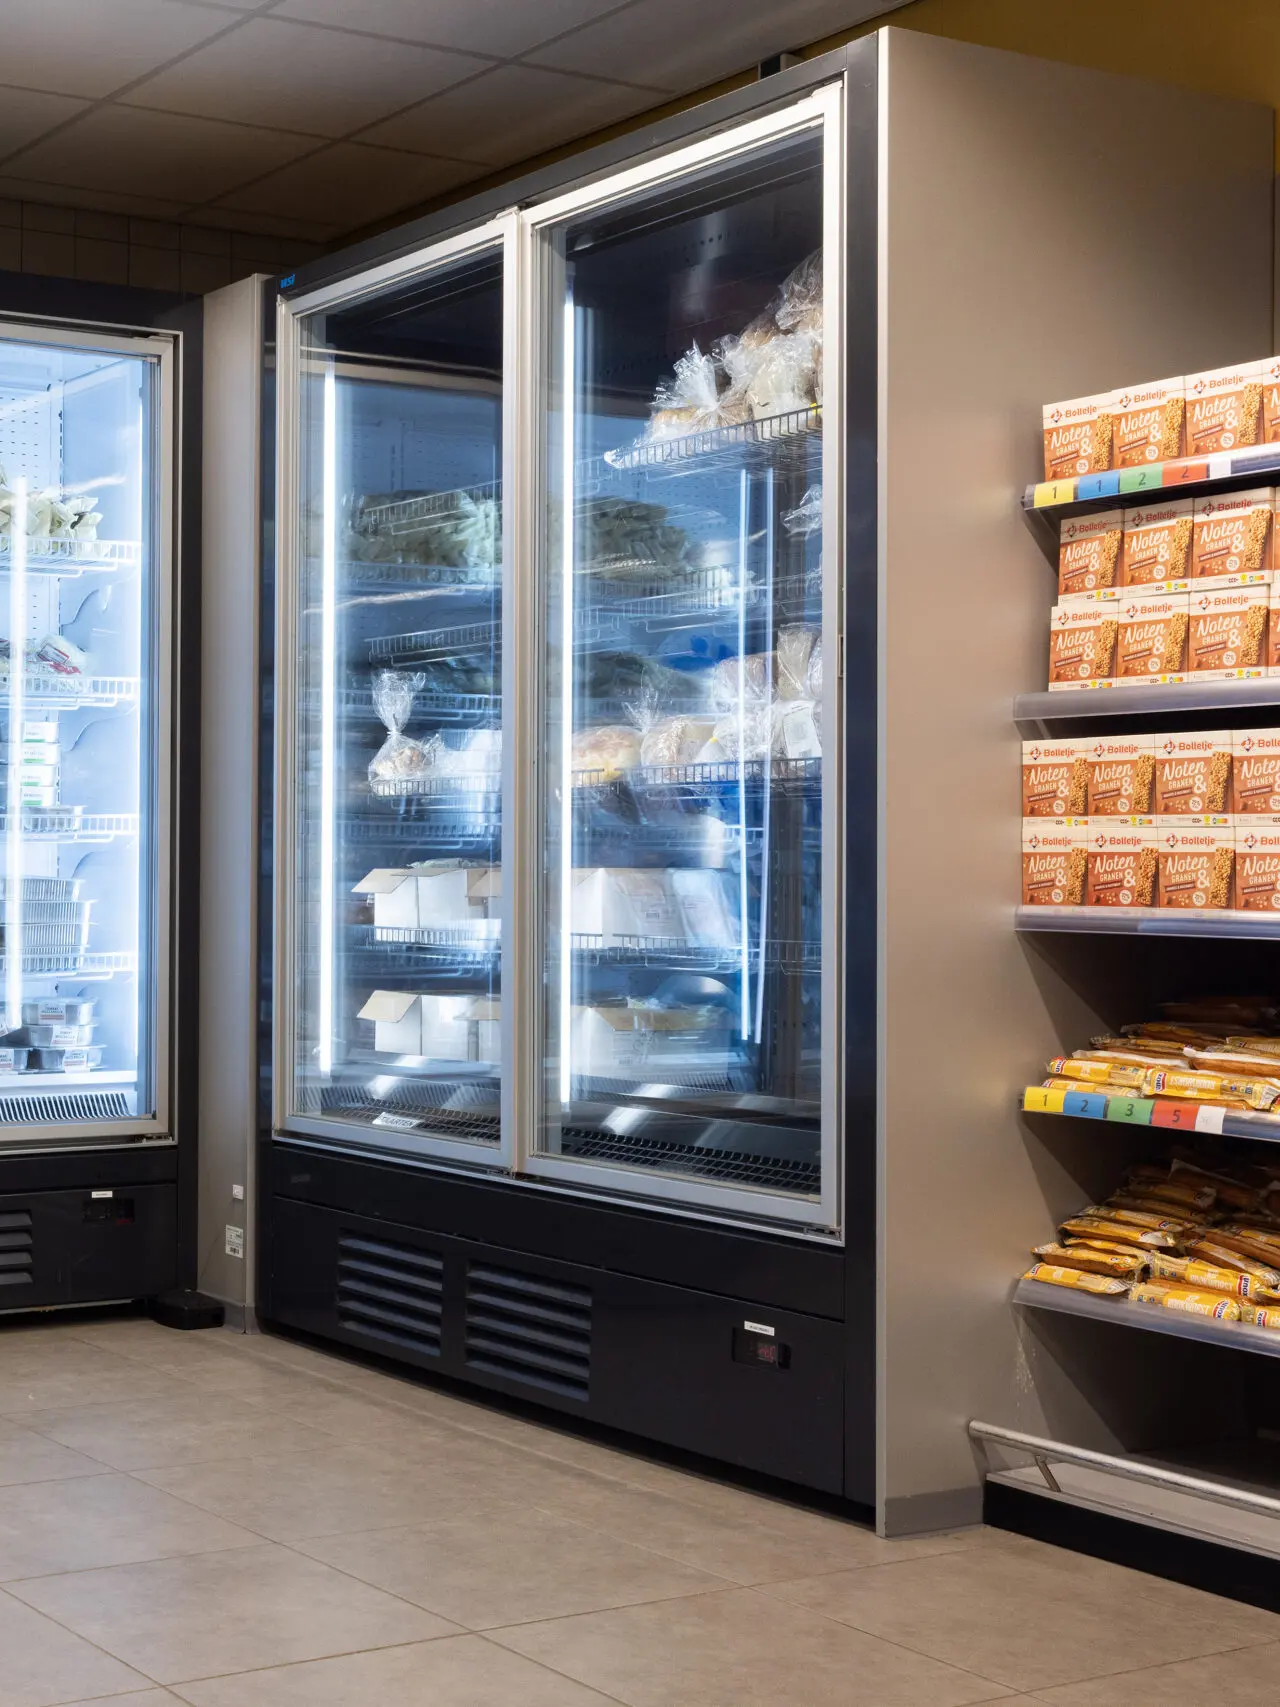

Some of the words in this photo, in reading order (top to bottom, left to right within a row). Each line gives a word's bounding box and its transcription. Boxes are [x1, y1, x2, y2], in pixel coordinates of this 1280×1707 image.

[1193, 396, 1238, 423] Noten
[1120, 410, 1161, 436] Noten
[1051, 425, 1092, 450] Noten
[1052, 487, 1057, 499] 1
[1096, 480, 1102, 492] 1
[1138, 473, 1146, 486] 2
[1181, 465, 1190, 479] 2
[1130, 530, 1170, 553] Noten
[1200, 520, 1245, 544] Noten
[1065, 540, 1100, 564] Noten
[1124, 623, 1167, 645] Noten
[1197, 615, 1242, 637] Noten
[1056, 630, 1096, 651] Noten
[1029, 766, 1069, 786] Noten
[1094, 764, 1133, 784] Noten
[1163, 761, 1207, 781] Noten
[1029, 855, 1066, 874] Noten
[1095, 855, 1136, 874] Noten
[1166, 855, 1209, 875] Noten
[1043, 1095, 1048, 1106] 1
[1080, 1100, 1088, 1112] 2
[1125, 1104, 1134, 1116] 3
[1172, 1110, 1181, 1123] 5
